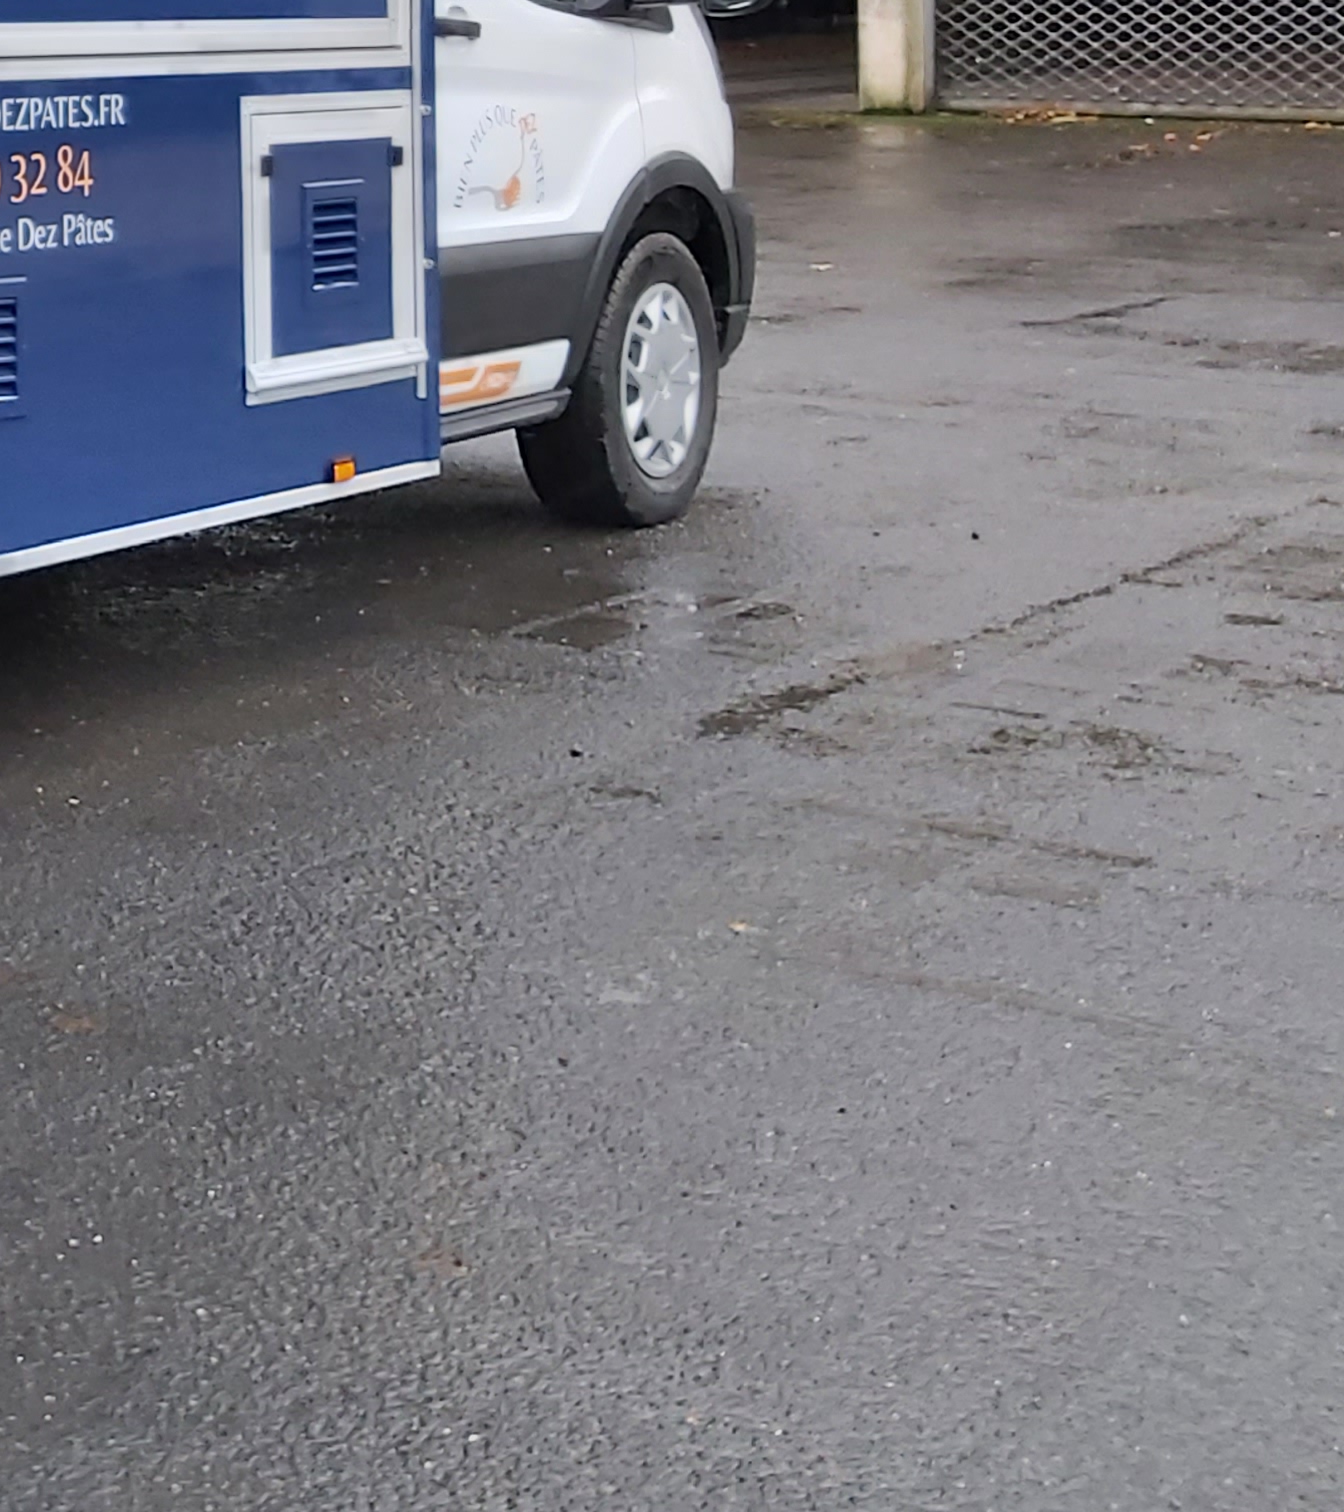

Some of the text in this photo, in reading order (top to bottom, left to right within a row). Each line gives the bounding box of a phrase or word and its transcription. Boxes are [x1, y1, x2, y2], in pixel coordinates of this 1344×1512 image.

[10, 153, 47, 204] 32
[57, 144, 94, 198] 84
[18, 217, 58, 251] Dez
[63, 213, 115, 246] Pâtes
